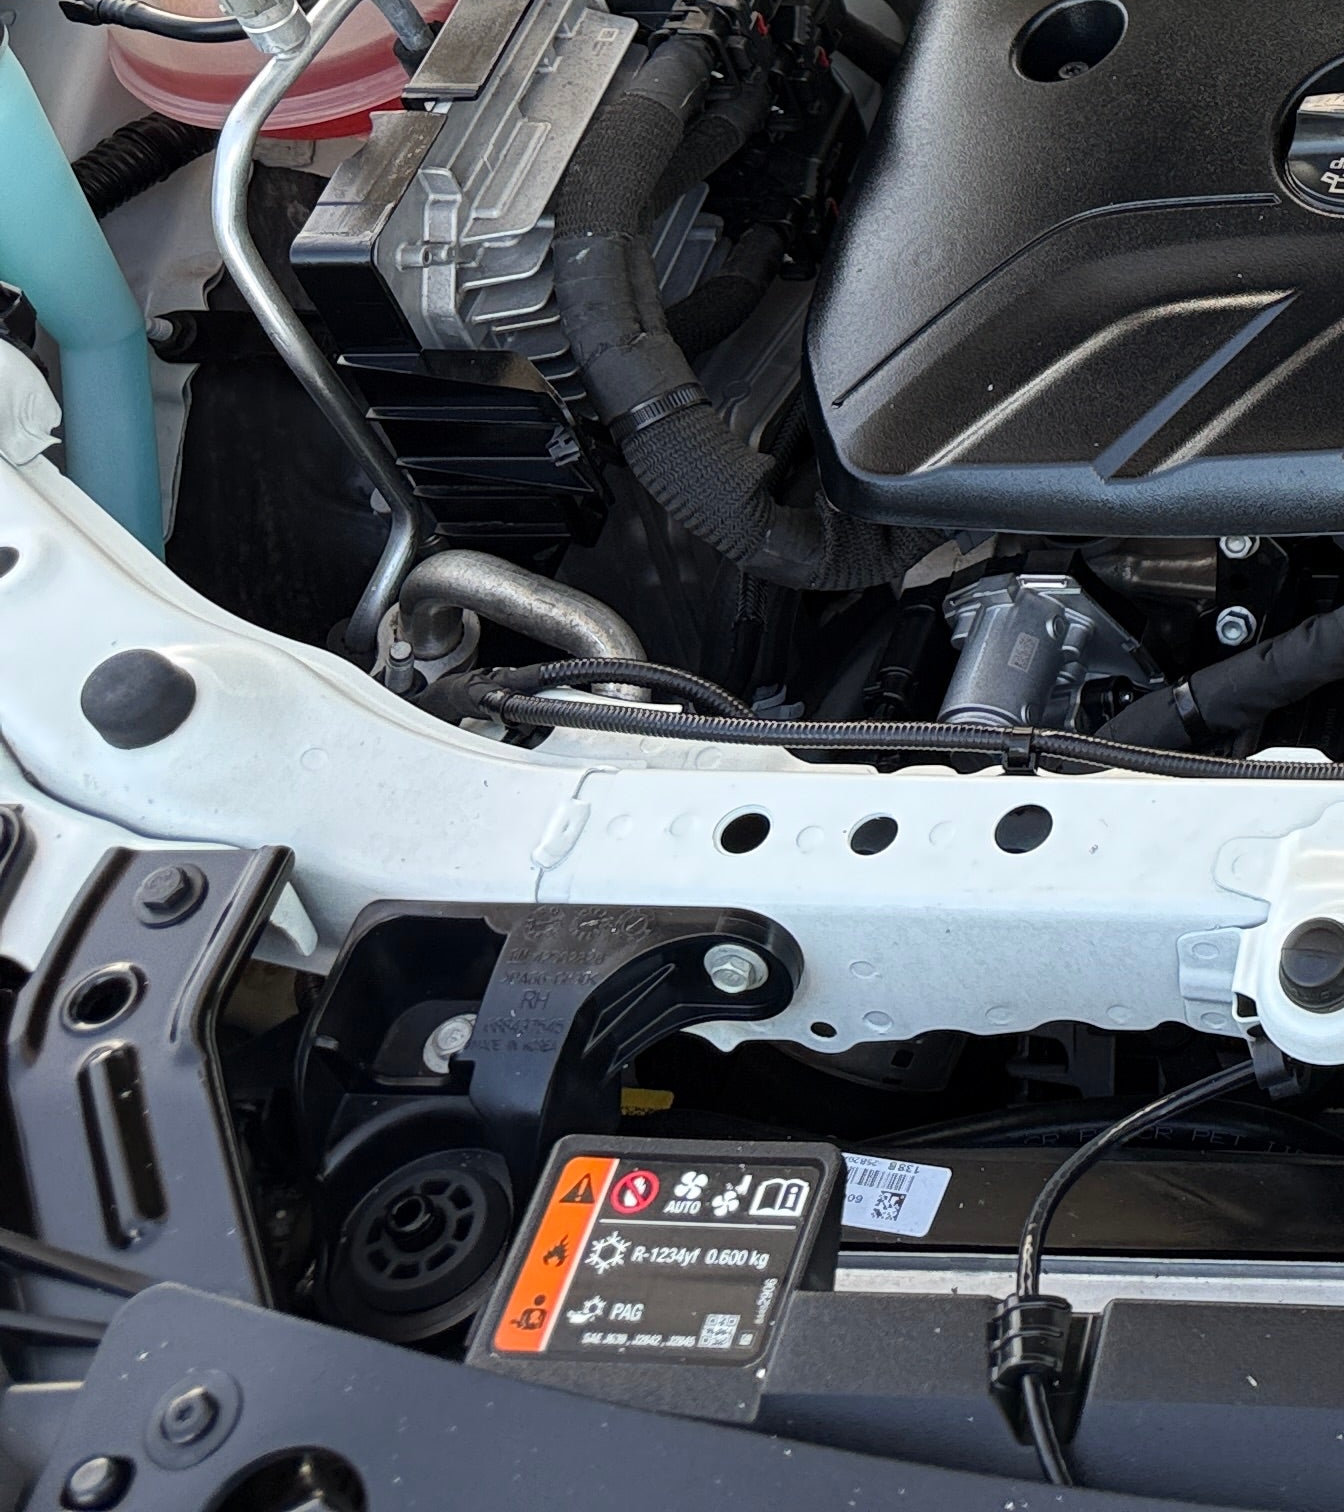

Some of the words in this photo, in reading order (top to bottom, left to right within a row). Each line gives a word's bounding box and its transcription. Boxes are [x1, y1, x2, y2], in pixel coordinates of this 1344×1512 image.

[521, 989, 550, 1009] RH
[663, 1200, 702, 1215] AUTO
[630, 1245, 702, 1267] R-1234yf
[704, 1247, 748, 1266] 0.600
[748, 1248, 771, 1270] kg
[609, 1302, 645, 1321] PAG
